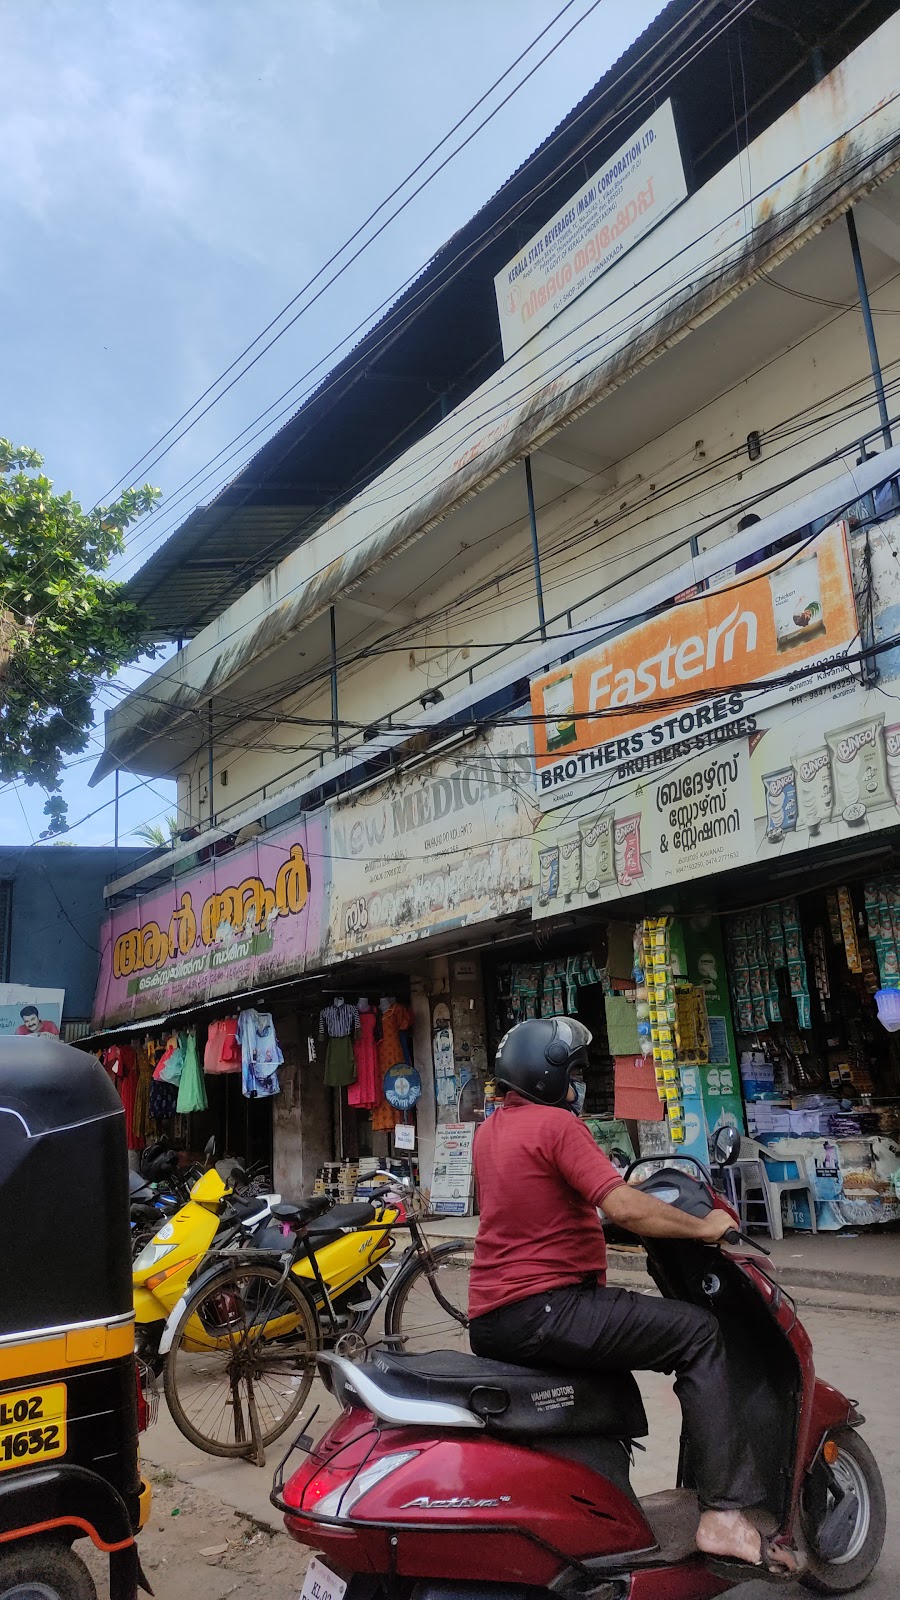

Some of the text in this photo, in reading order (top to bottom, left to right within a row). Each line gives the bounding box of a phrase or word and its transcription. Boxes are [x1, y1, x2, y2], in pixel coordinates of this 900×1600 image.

[507, 128, 656, 285] KERALA STATE BEVERAGES (M&M) CORPORATION LTD.
[567, 232, 583, 254] KERALA
[583, 199, 617, 238] UNDERTAKING)
[588, 241, 623, 280] CHINNAKKADA
[775, 590, 796, 602] Chicken
[587, 602, 758, 723] Eastern
[541, 691, 745, 789] BROTHERS STORES
[751, 734, 761, 747] NEW
[838, 725, 877, 759] BINGO!
[391, 741, 532, 836] MEDICALS
[660, 833, 669, 854] &
[699, 846, 724, 859] KAVANAD
[531, 1390, 552, 1402] VAHINI
[551, 1385, 575, 1398] MOTORS
[0, 1396, 43, 1426] L-02
[0, 1425, 60, 1461] 1632
[399, 1496, 500, 1509] Activa
